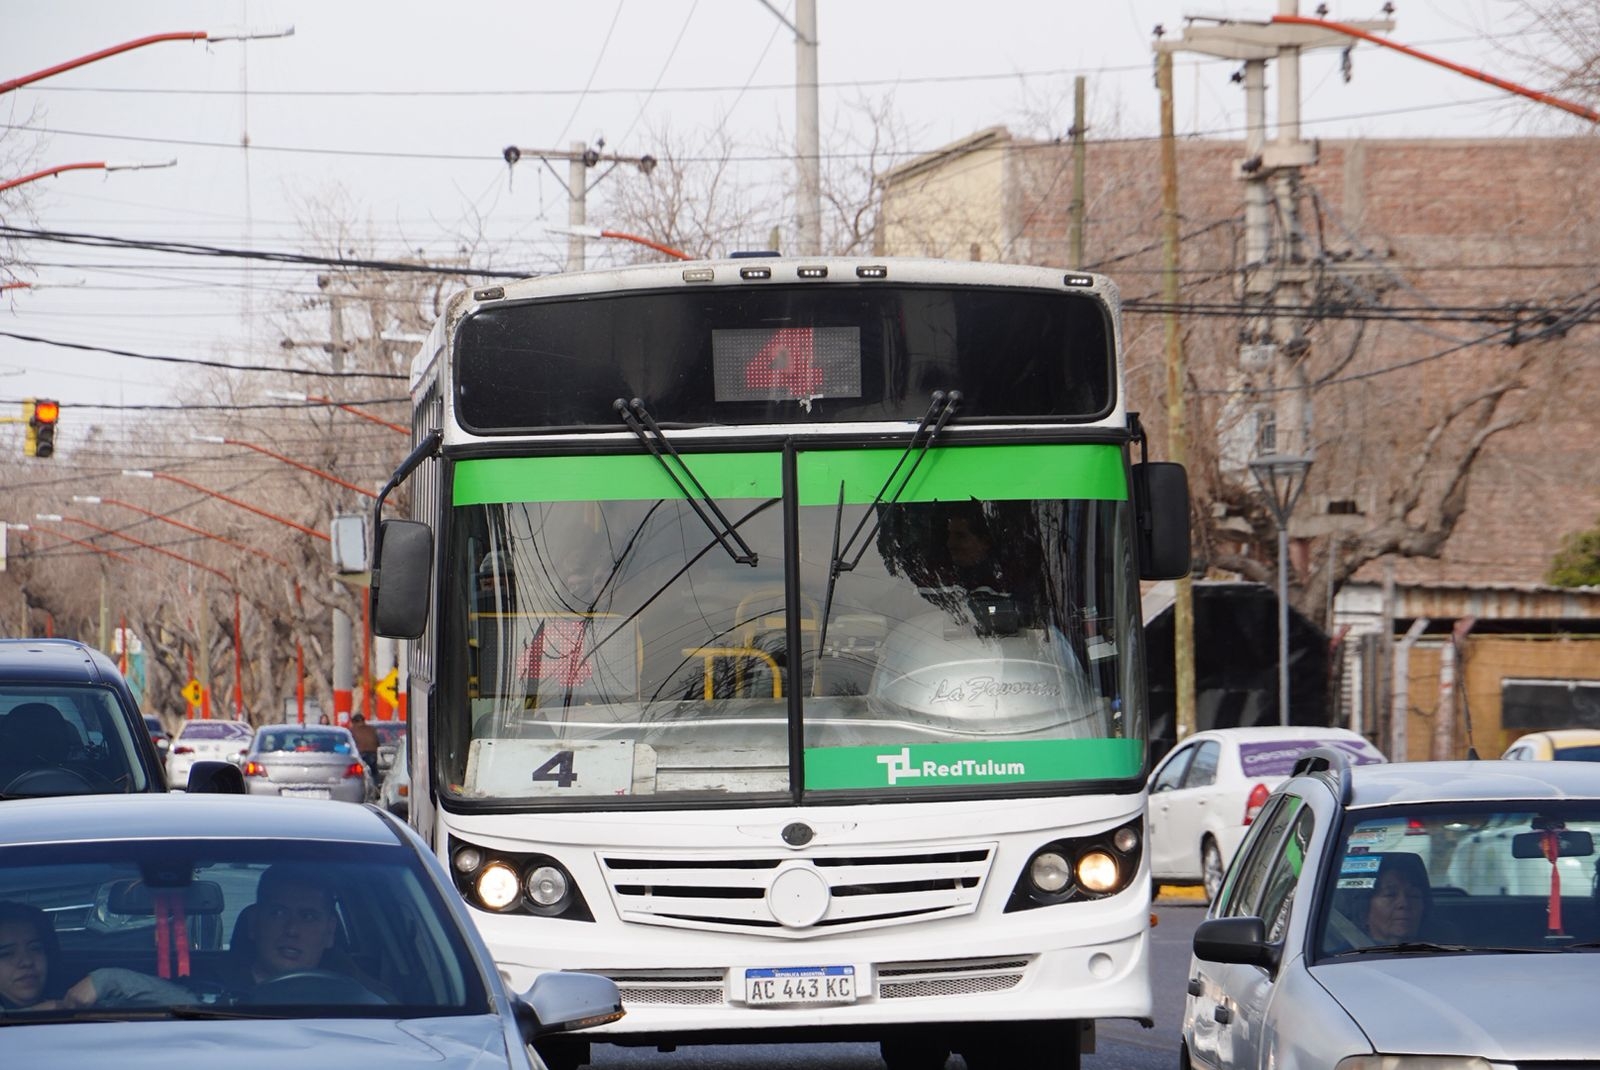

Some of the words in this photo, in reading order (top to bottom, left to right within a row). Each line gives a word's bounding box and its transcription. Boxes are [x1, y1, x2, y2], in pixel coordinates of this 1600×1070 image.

[745, 328, 823, 396] 4
[517, 621, 592, 687] 4
[930, 679, 964, 704] La
[966, 676, 1061, 702] Favorita
[532, 750, 577, 787] 4
[922, 760, 1025, 777] RedTulum
[752, 980, 775, 1000] AC
[783, 979, 819, 998] 443
[826, 978, 850, 997] KC
